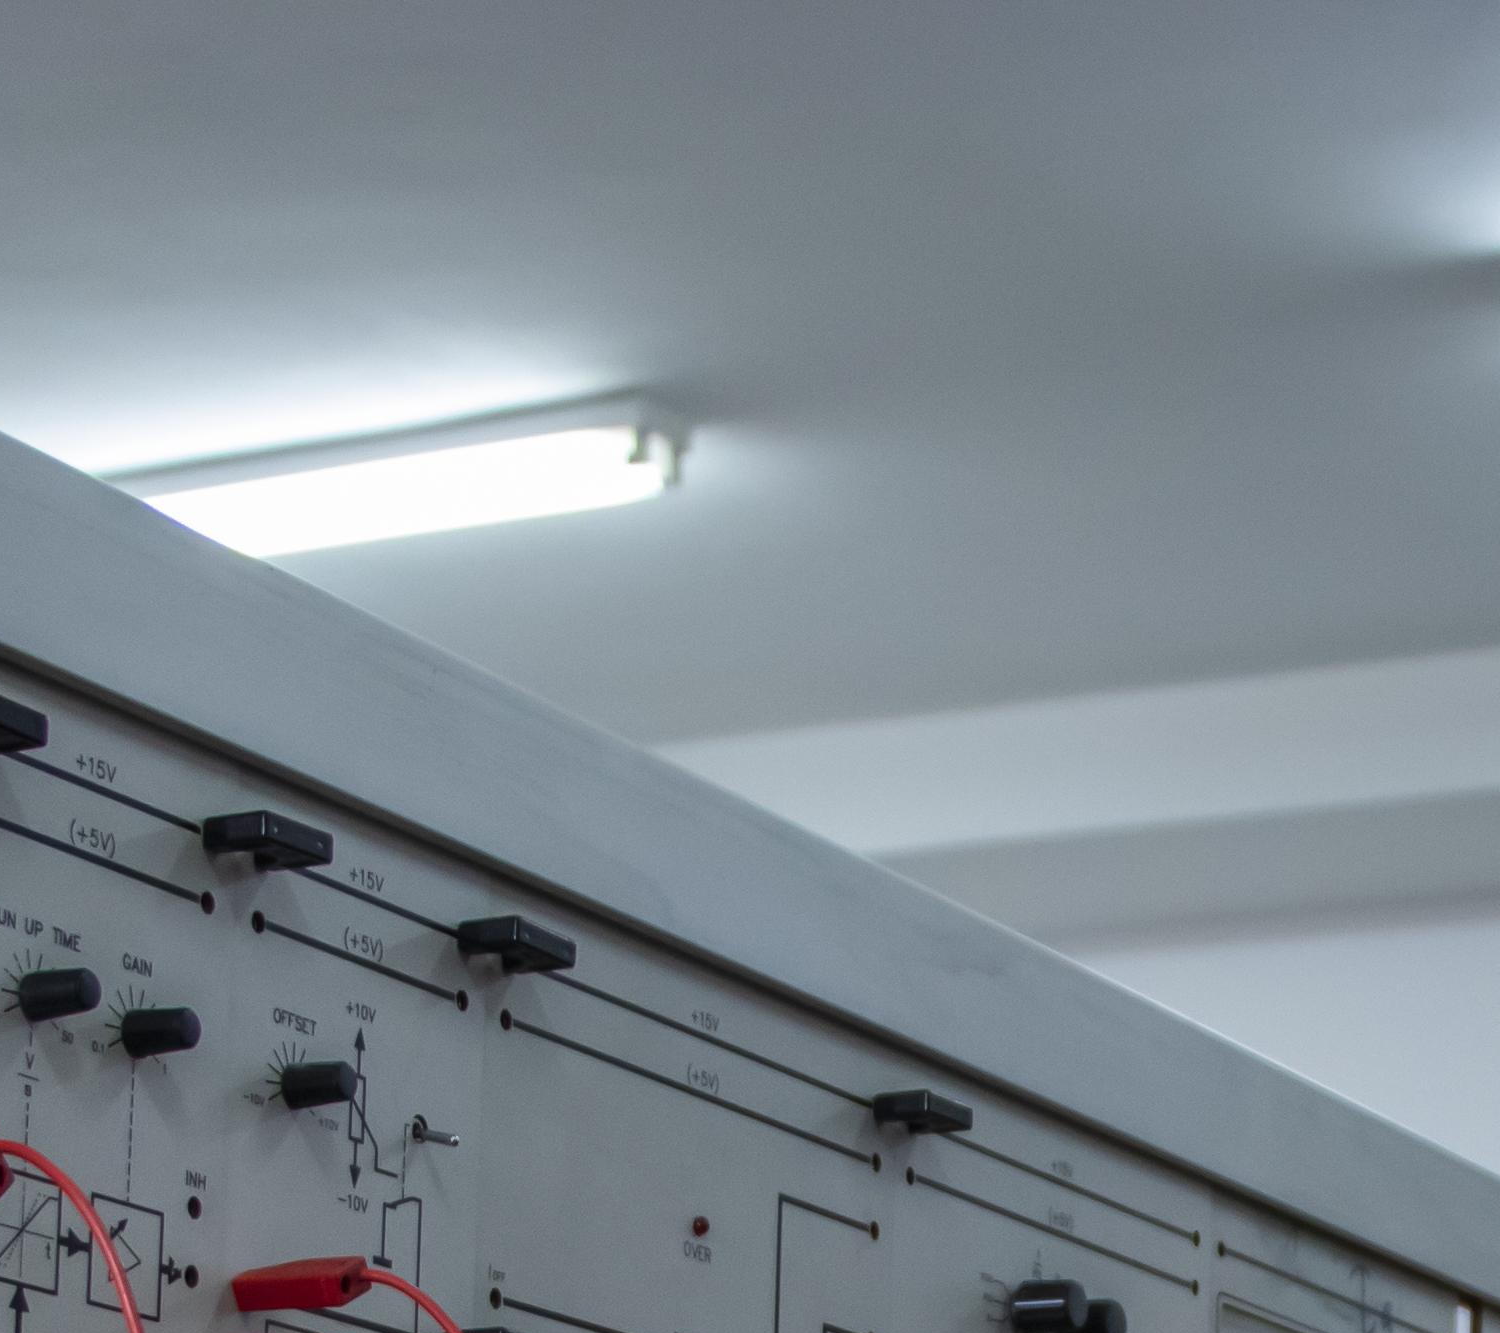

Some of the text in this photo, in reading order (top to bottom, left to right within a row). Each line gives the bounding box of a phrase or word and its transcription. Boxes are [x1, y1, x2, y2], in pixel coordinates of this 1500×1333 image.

[75, 753, 118, 784] +15V
[69, 817, 117, 859] (+5V)
[349, 867, 385, 893] +15V
[23, 916, 45, 939] UP
[51, 927, 82, 953] TIME
[343, 926, 384, 962] (+5V)
[122, 952, 154, 979] GAIN
[272, 1006, 318, 1039] OFFSET
[345, 1001, 377, 1025] +10V
[690, 1008, 721, 1034] +15V
[686, 1062, 721, 1096] (+5V)
[185, 1169, 207, 1192] INH
[337, 1193, 369, 1215] -10V
[682, 1240, 713, 1265] OVER
